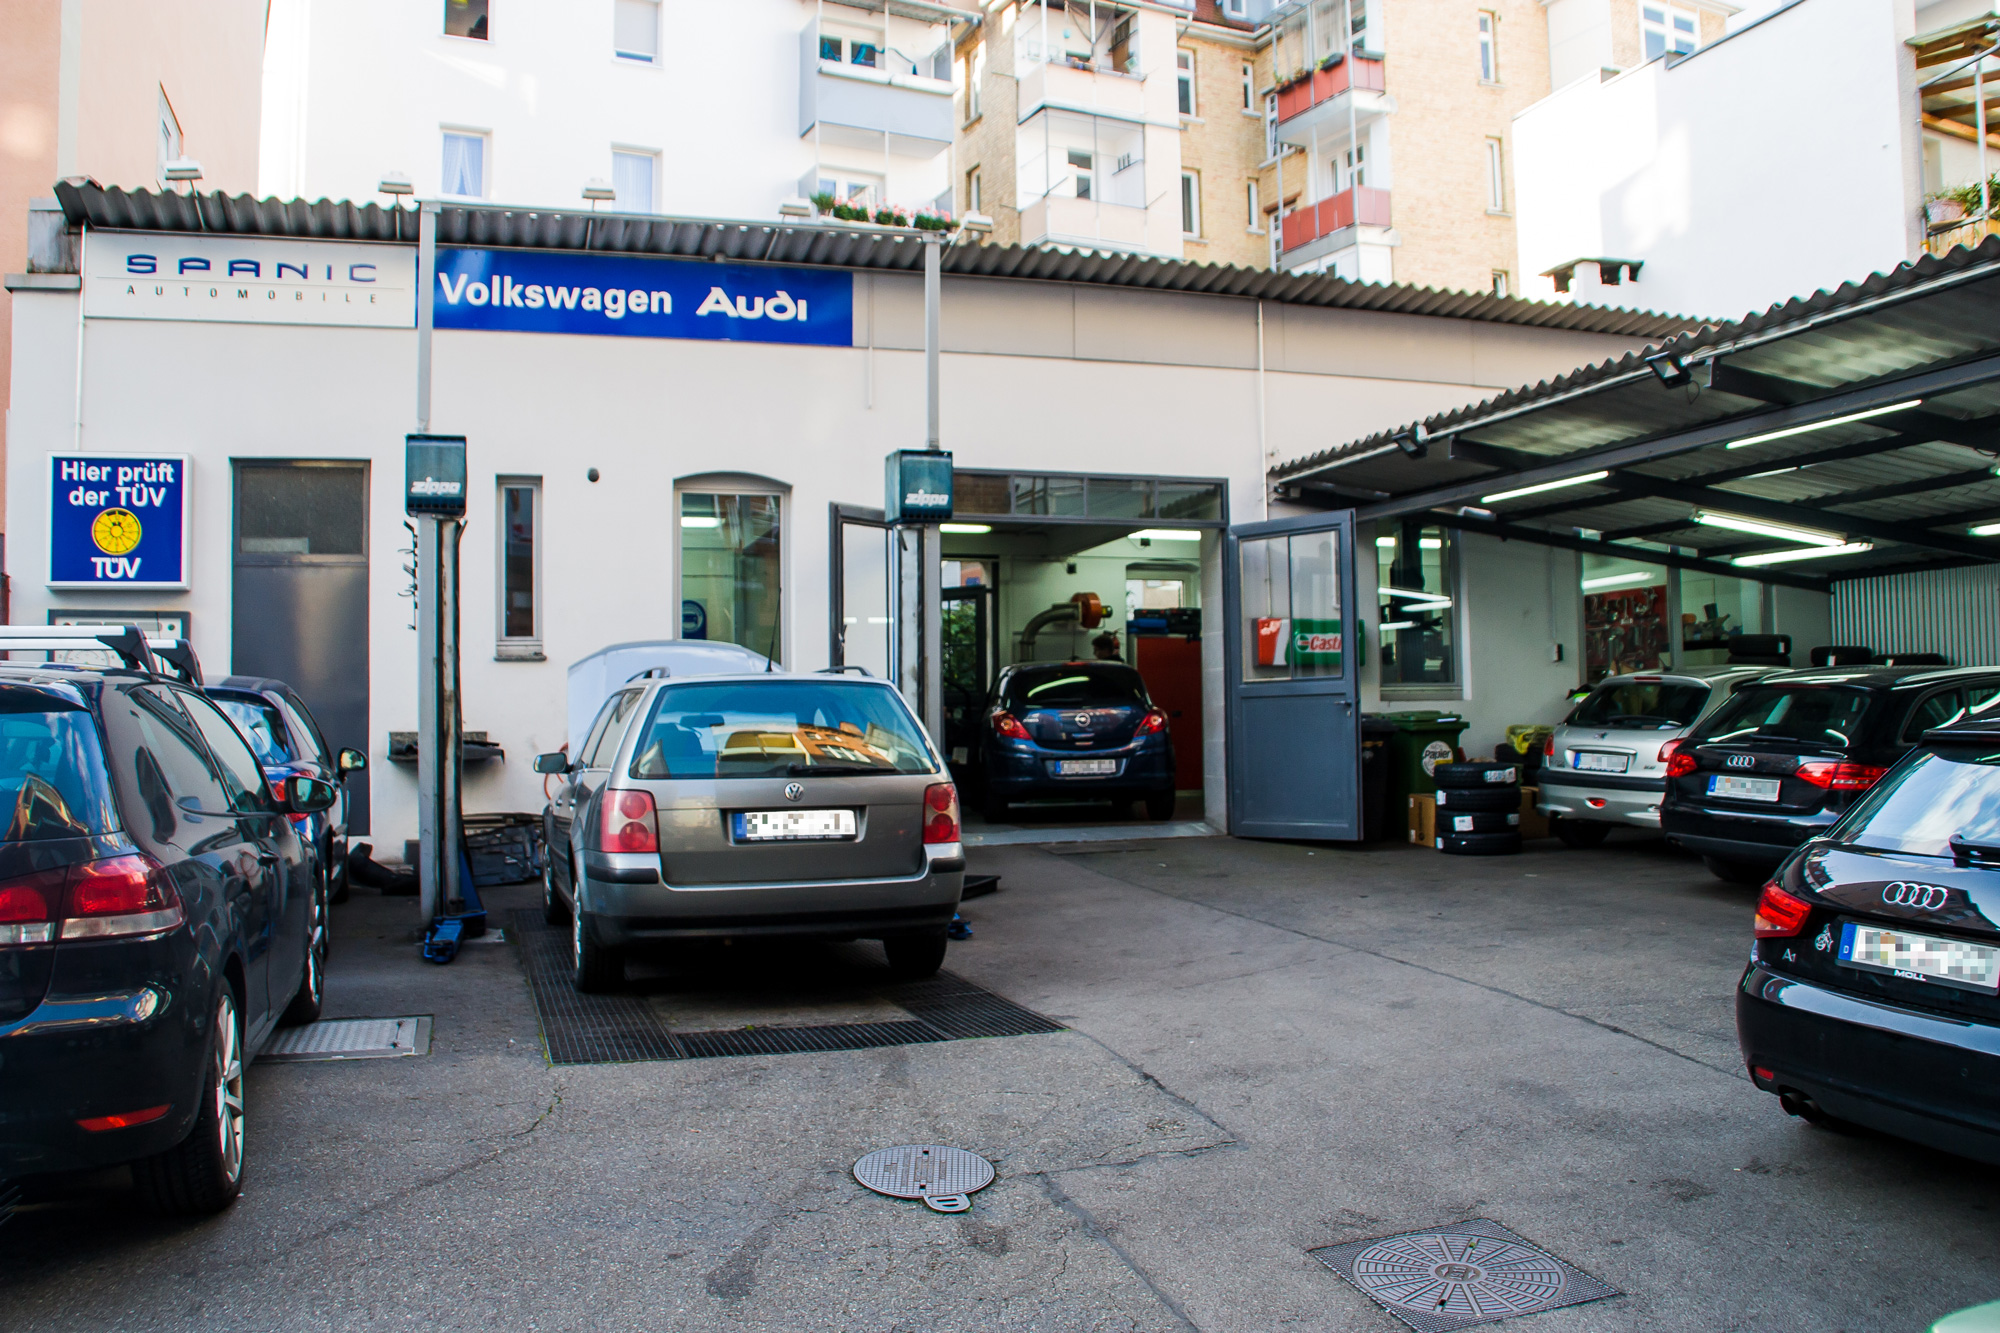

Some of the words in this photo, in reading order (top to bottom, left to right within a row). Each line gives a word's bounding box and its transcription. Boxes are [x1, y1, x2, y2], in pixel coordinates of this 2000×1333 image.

[127, 254, 376, 283] SPANIC
[127, 285, 376, 303] AUTOMOBILE
[438, 272, 672, 319] Volkswagen
[696, 287, 807, 321] Audi
[61, 461, 112, 481] Hier
[117, 462, 175, 486] prüft
[69, 486, 110, 506] der
[115, 483, 167, 507] TÜV
[411, 476, 462, 495] zippo
[905, 489, 949, 507] zippo
[91, 557, 142, 578] TÜV
[1423, 749, 1451, 760] Papier
[1782, 948, 1797, 962] A1
[1894, 970, 1926, 981] MOLL
